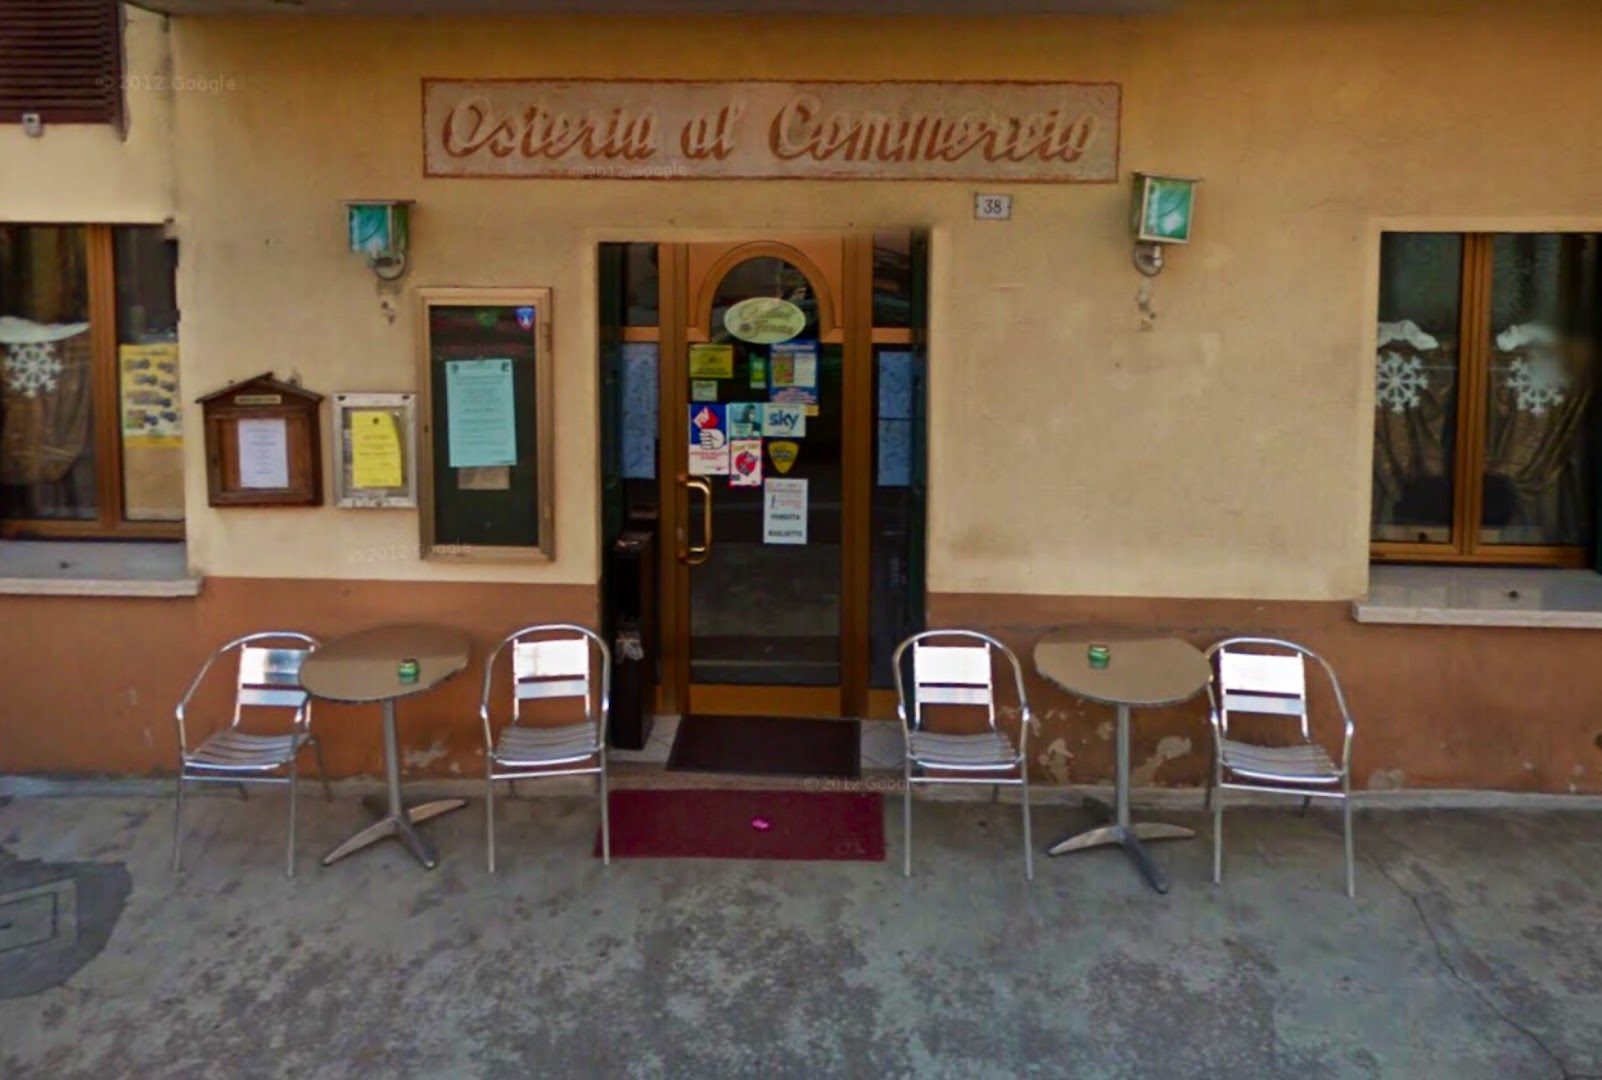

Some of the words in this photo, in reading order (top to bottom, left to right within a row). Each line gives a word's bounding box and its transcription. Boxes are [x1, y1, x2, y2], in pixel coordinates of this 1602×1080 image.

[442, 98, 655, 160] Osteria
[680, 100, 747, 161] al
[769, 96, 1099, 162] Commercio
[983, 198, 1002, 215] 38
[769, 408, 799, 430] sky
